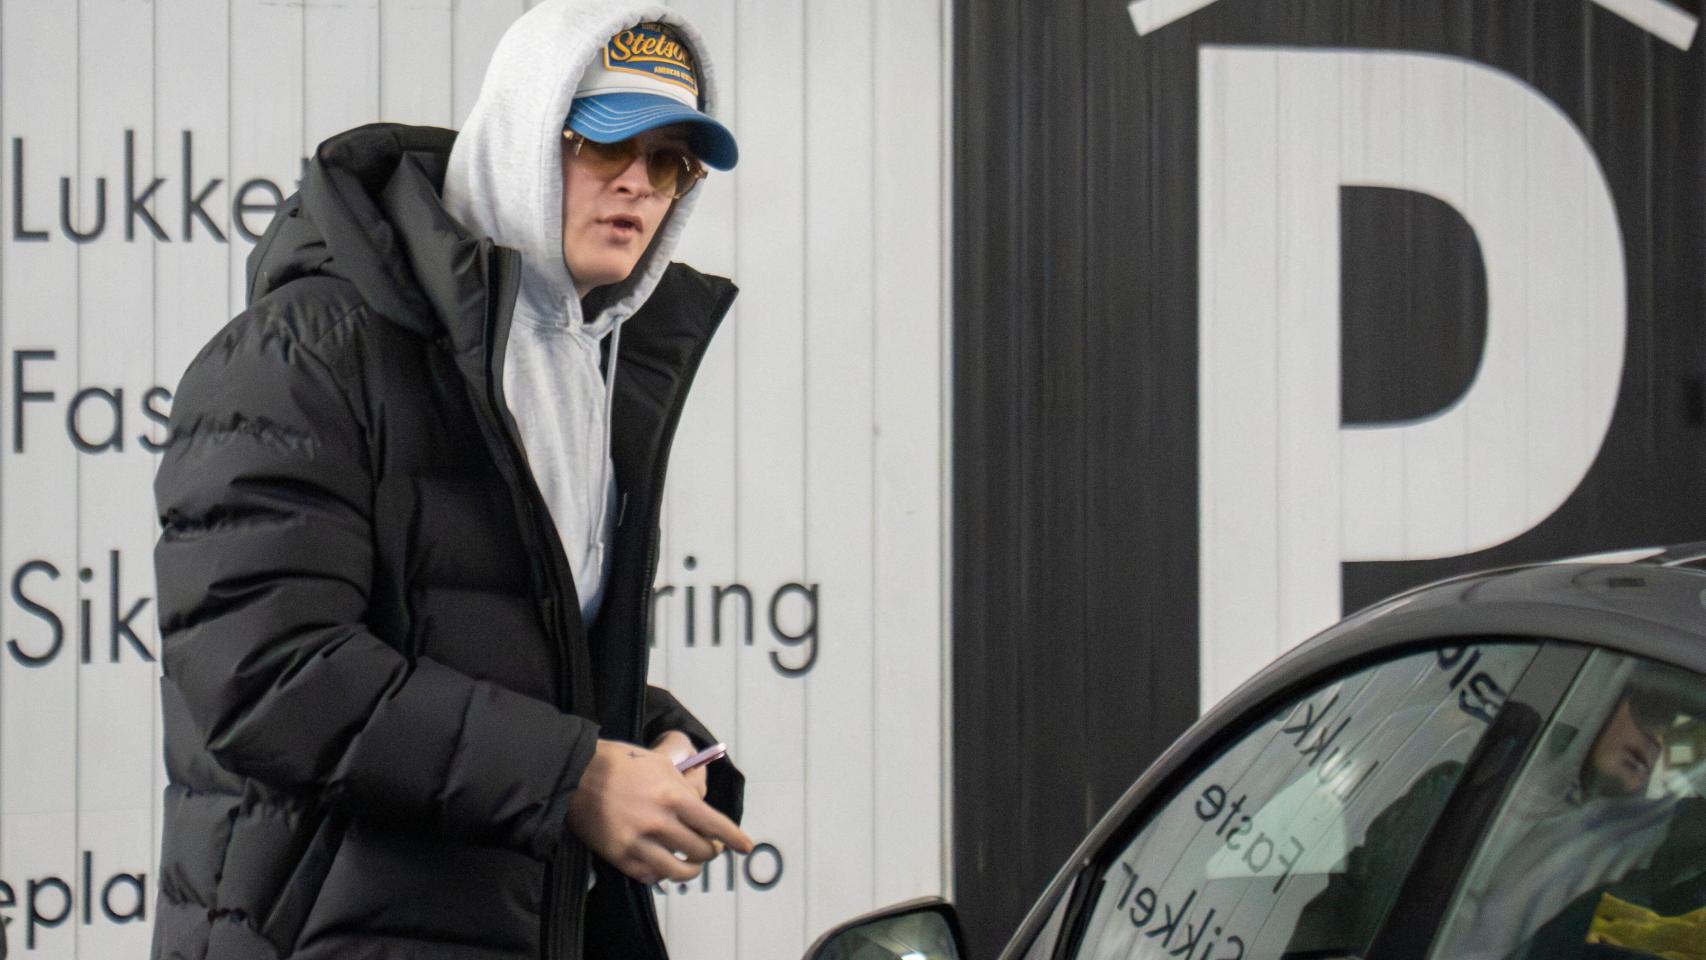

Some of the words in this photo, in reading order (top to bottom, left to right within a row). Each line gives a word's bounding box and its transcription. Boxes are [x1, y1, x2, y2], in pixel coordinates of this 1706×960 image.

[609, 30, 689, 64] Stetso
[12, 129, 312, 245] Lukke
[13, 349, 173, 455] Fas
[1198, 43, 1627, 720] P
[6, 550, 157, 668] Sik
[648, 555, 820, 679] ring
